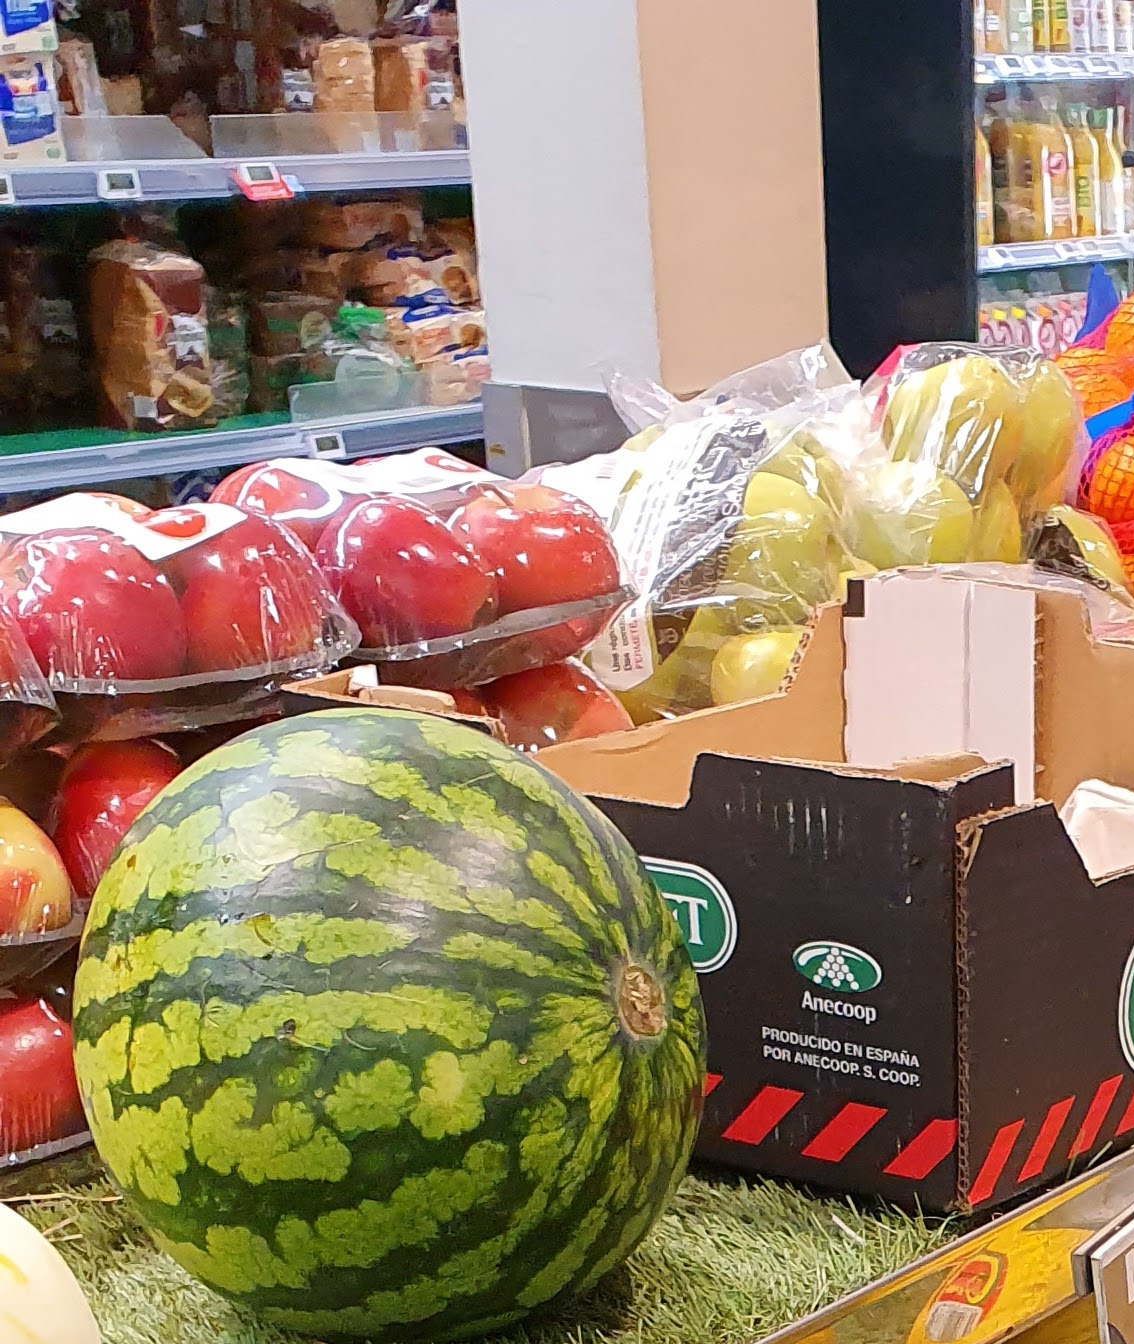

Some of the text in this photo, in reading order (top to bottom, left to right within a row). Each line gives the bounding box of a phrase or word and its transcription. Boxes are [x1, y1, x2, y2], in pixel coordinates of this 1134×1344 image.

[801, 990, 877, 1025] Anecoop
[761, 1026, 920, 1068] PRODUCIDO EN ESPAÑA
[763, 1045, 792, 1062] POR
[863, 1065, 876, 1080] S.
[878, 1068, 921, 1087] COOP.
